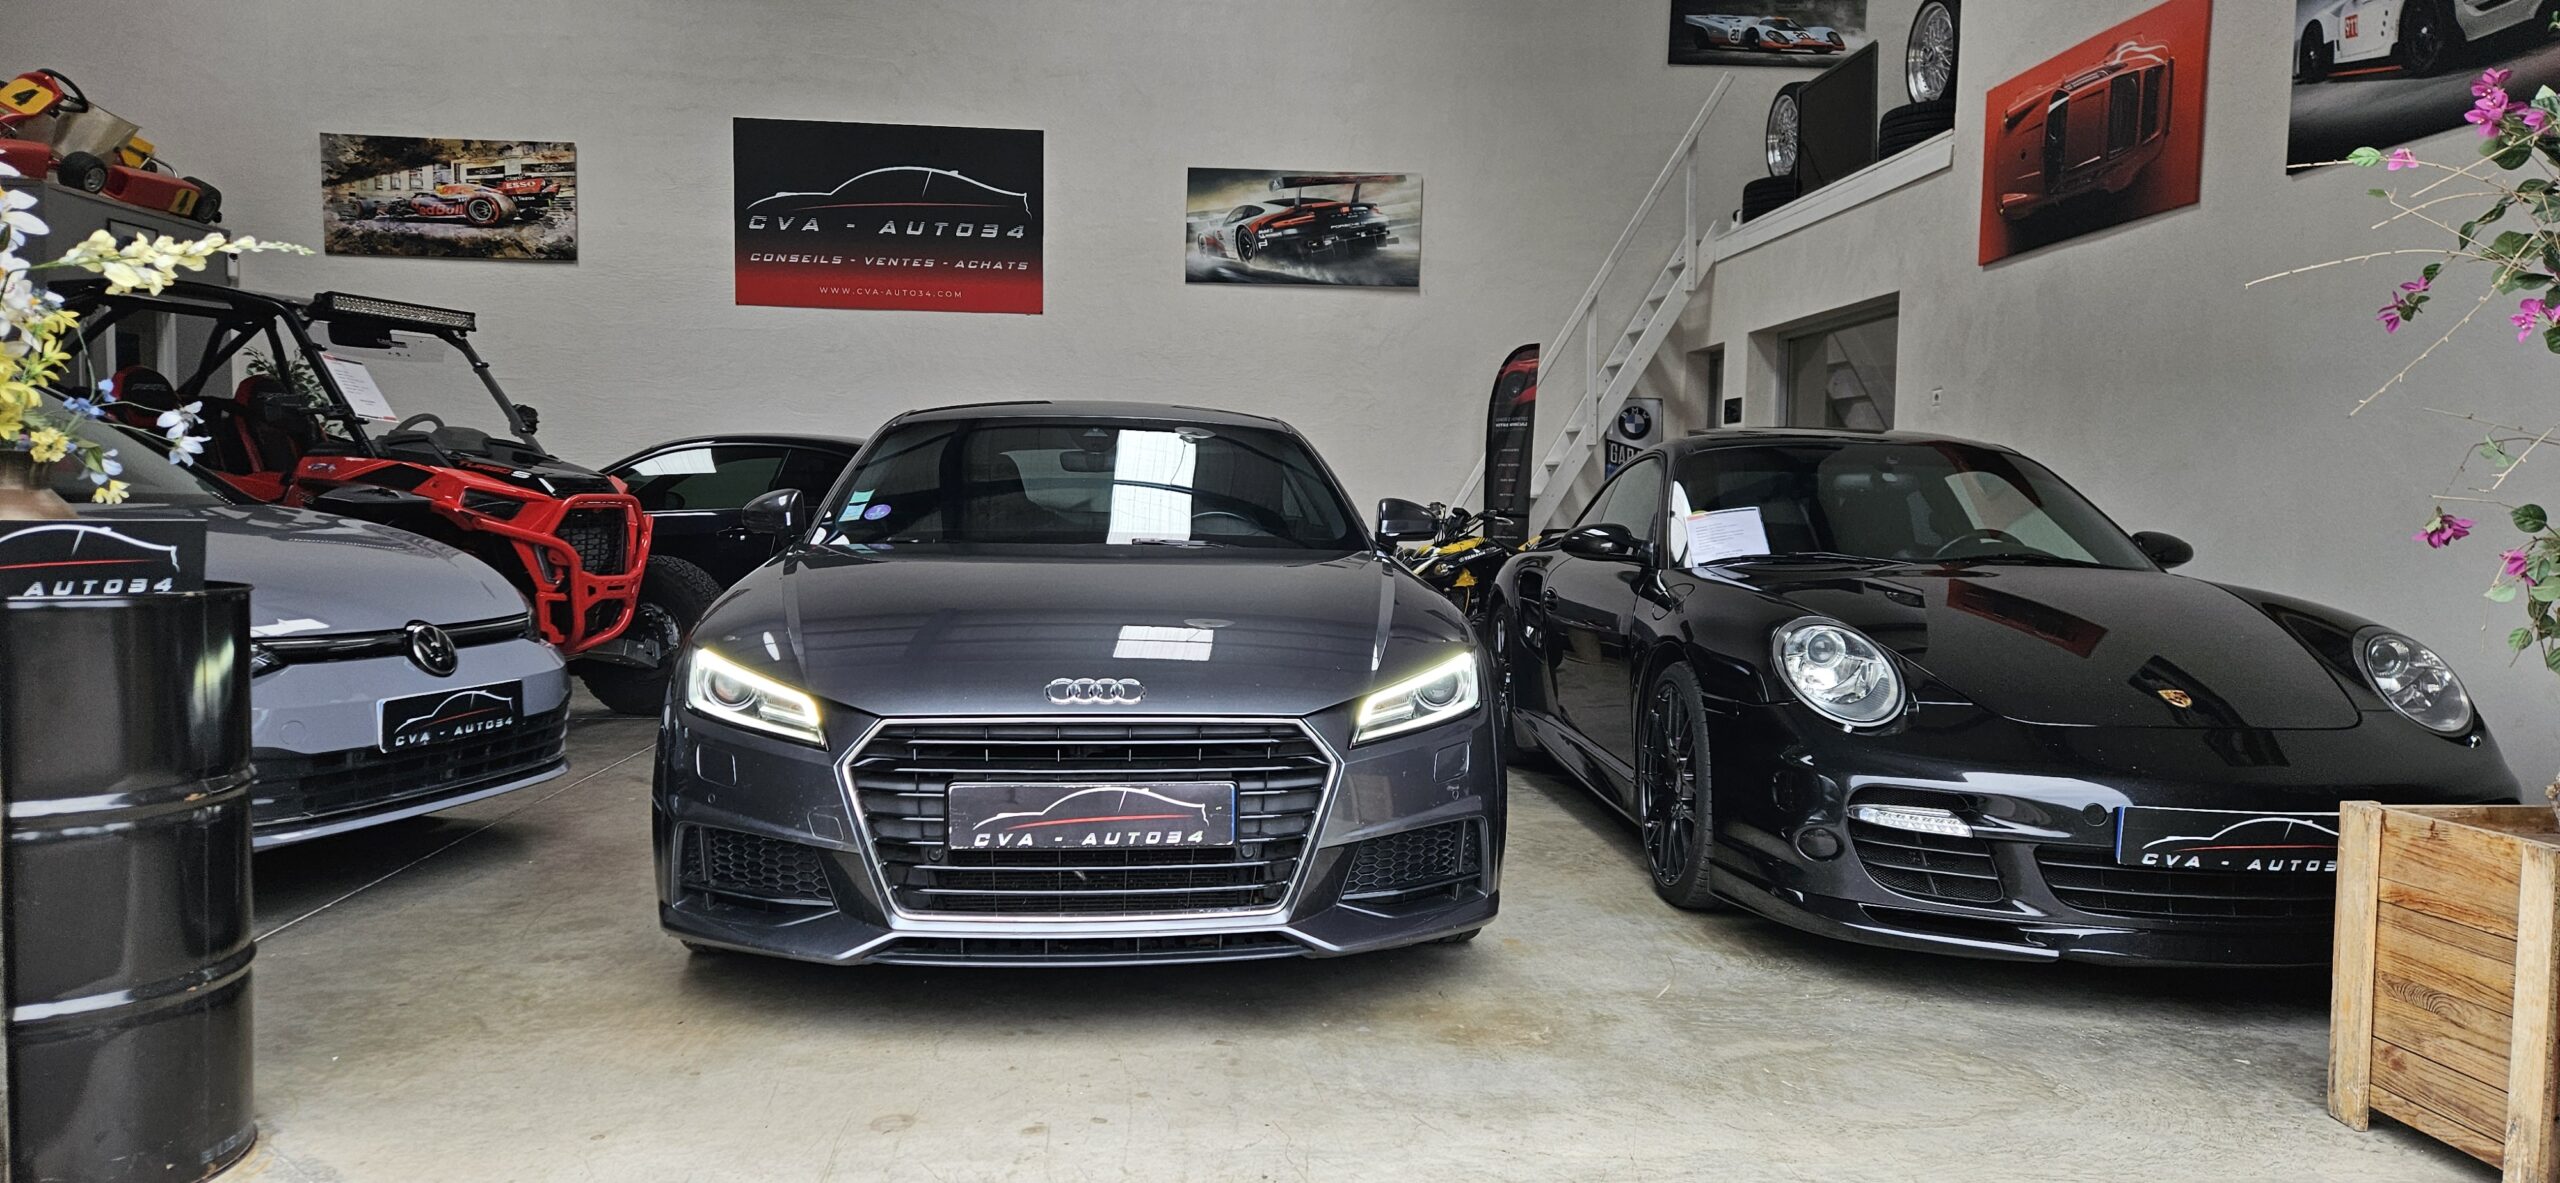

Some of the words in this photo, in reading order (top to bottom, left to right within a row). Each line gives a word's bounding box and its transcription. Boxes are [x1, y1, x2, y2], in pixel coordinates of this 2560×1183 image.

[11, 88, 40, 107] 4
[505, 181, 537, 189] ESSO
[749, 215, 820, 232] CVA
[878, 220, 1025, 239] AUTO34
[750, 252, 843, 265] CONSEILS
[864, 256, 936, 268] VENTES
[954, 258, 1029, 271] ACHATS
[818, 285, 963, 298] WWW.CVA-AUTO34.COM
[1621, 407, 1650, 419] BMW
[23, 577, 173, 597] AUTO34
[394, 731, 431, 747] CVA
[453, 716, 514, 737] AUTO34
[973, 832, 1034, 847] CVA
[1081, 830, 1204, 847] AUTO34
[2141, 852, 2200, 868] CVA
[2246, 858, 2337, 872] AUTO3
